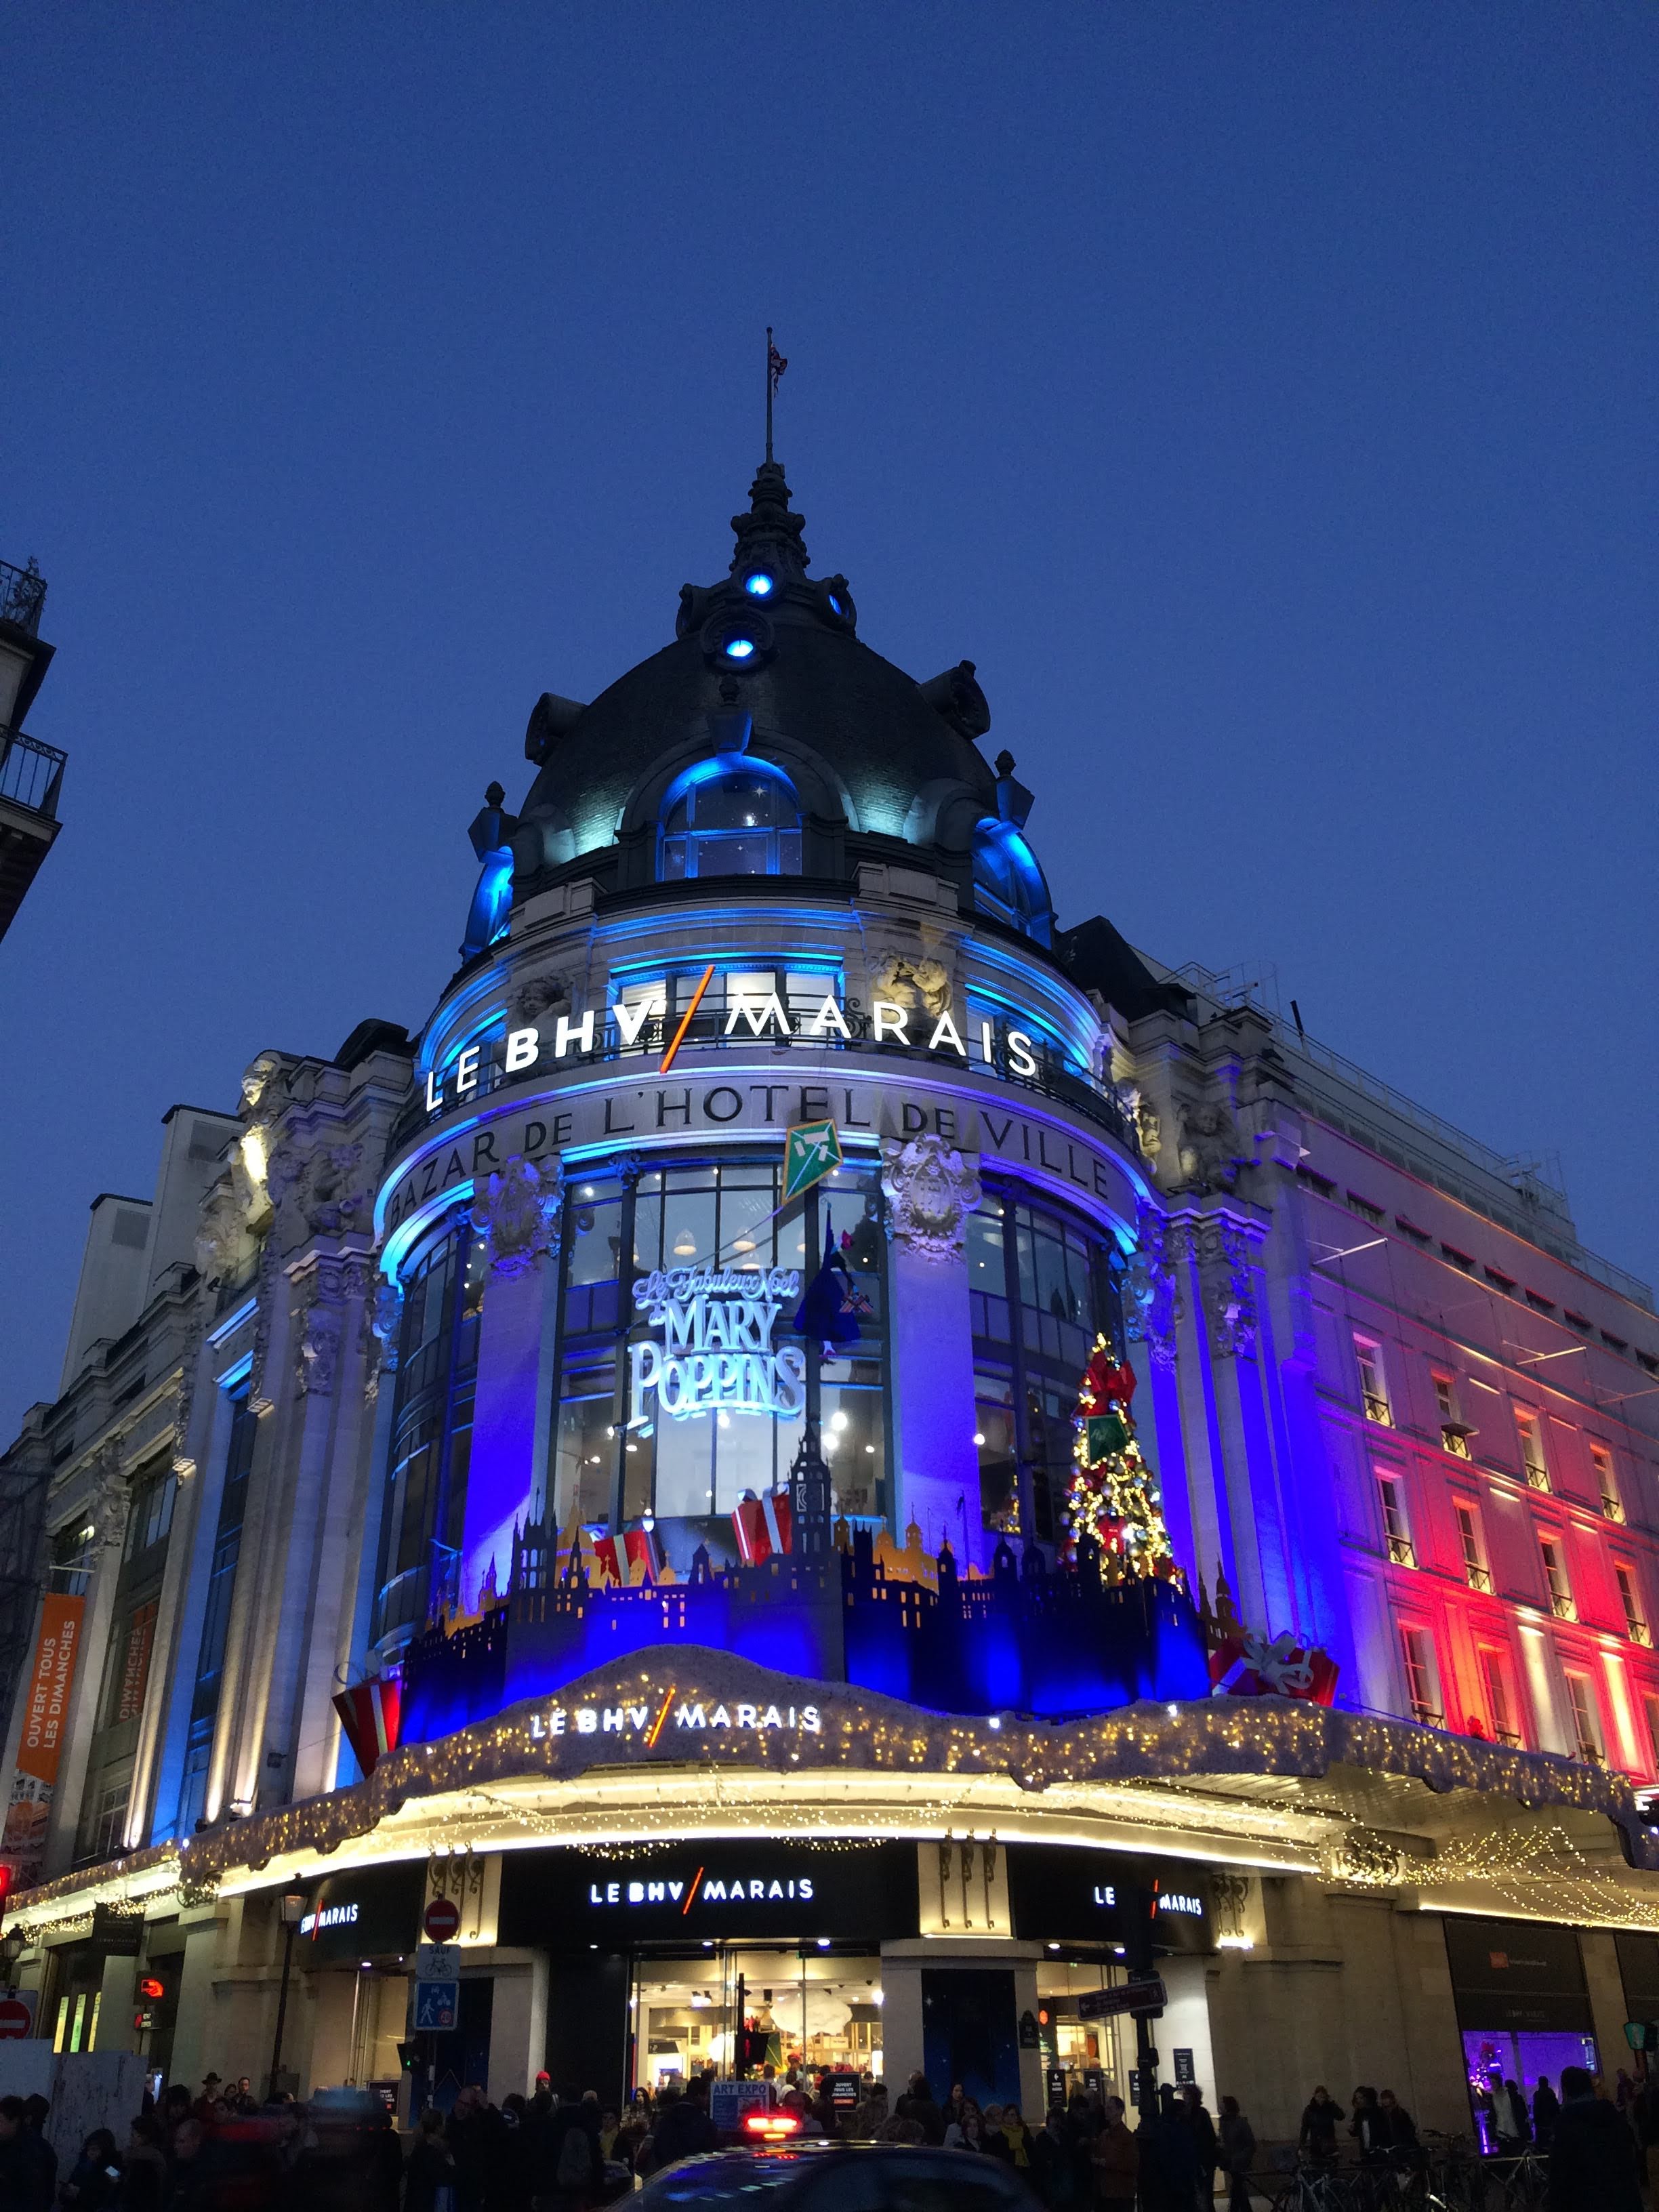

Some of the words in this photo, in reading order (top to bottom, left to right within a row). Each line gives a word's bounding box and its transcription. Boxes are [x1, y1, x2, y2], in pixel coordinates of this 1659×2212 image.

[426, 1046, 480, 1112] LE
[506, 1000, 653, 1073] BHV
[724, 991, 1036, 1077] MARAIS
[390, 1132, 499, 1233] BAZAR
[524, 1113, 573, 1153] DE
[902, 1102, 955, 1140] DE
[979, 1111, 1108, 1200] VILLE
[662, 1294, 783, 1361] MARY
[628, 1340, 806, 1430] POPPINS
[49, 1620, 75, 1715] DIMANCHES
[26, 1683, 48, 1748] OUVERT
[38, 1637, 56, 1680] TOUS
[43, 1719, 59, 1748] LES
[533, 1711, 566, 1738] LE
[577, 1706, 649, 1734] BHV
[677, 1703, 821, 1733] MARAIS
[591, 1883, 620, 1903] LE
[628, 1881, 684, 1902] BHV
[703, 1878, 813, 1900] MARAIS
[1094, 1886, 1115, 1905] LE
[1160, 1893, 1202, 1915] MARAIS
[318, 1903, 359, 1927] MARAIS
[714, 2084, 734, 2094] ART
[738, 2084, 766, 2094] EXPO
